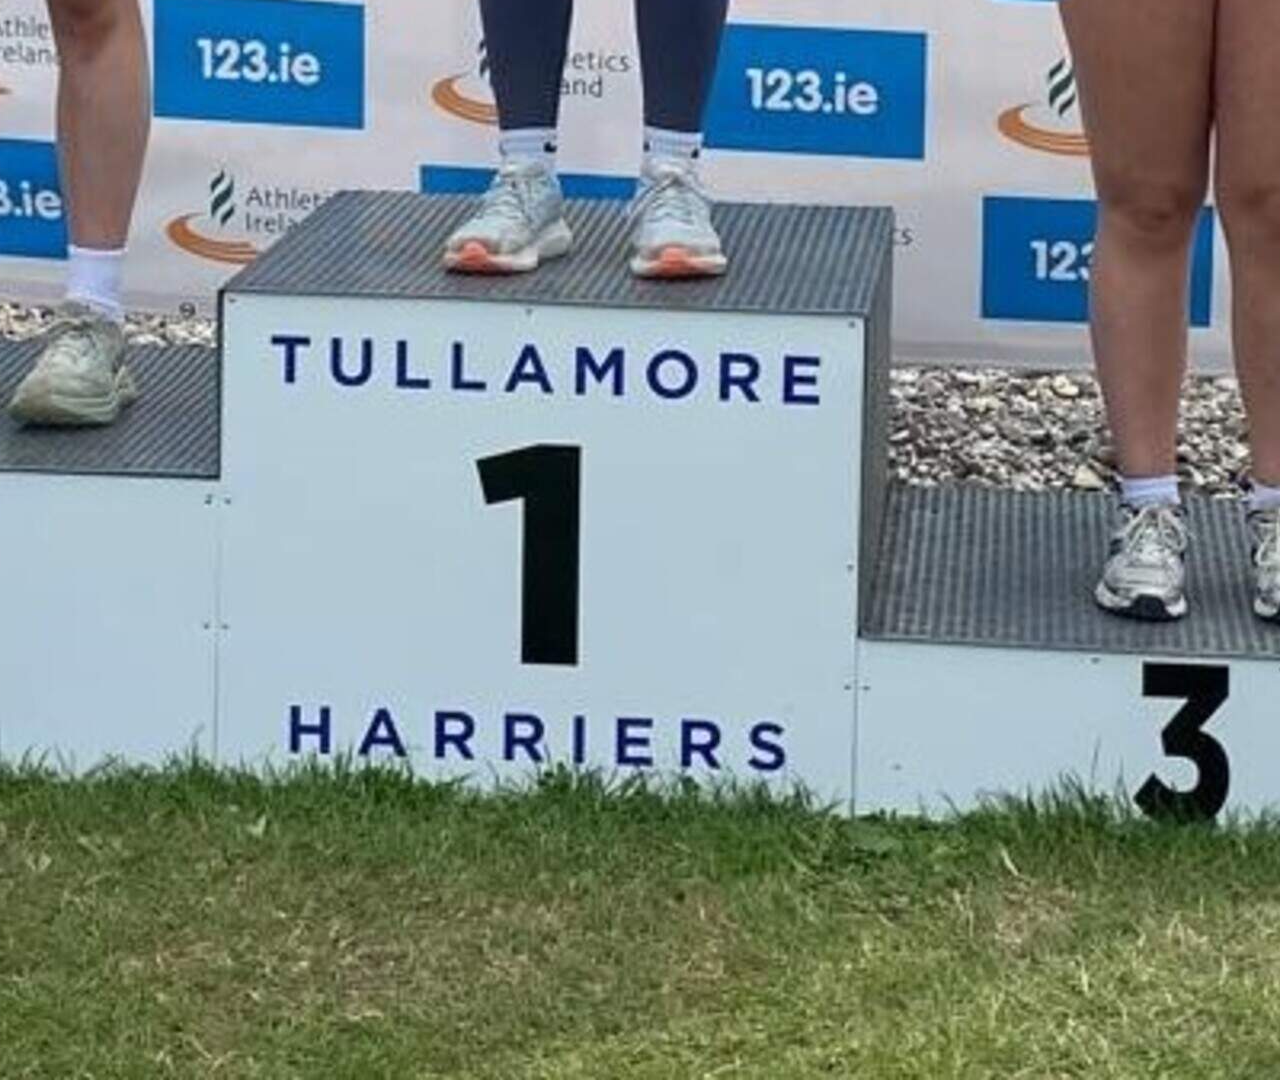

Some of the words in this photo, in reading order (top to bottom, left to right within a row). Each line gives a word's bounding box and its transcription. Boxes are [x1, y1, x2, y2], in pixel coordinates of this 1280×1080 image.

[197, 39, 320, 85] 123.ie
[746, 68, 878, 115] 123.ie
[270, 334, 822, 406] TULLAMORE
[476, 443, 582, 667] 1
[288, 705, 787, 772] HARRIERS
[1133, 663, 1231, 824] 3
